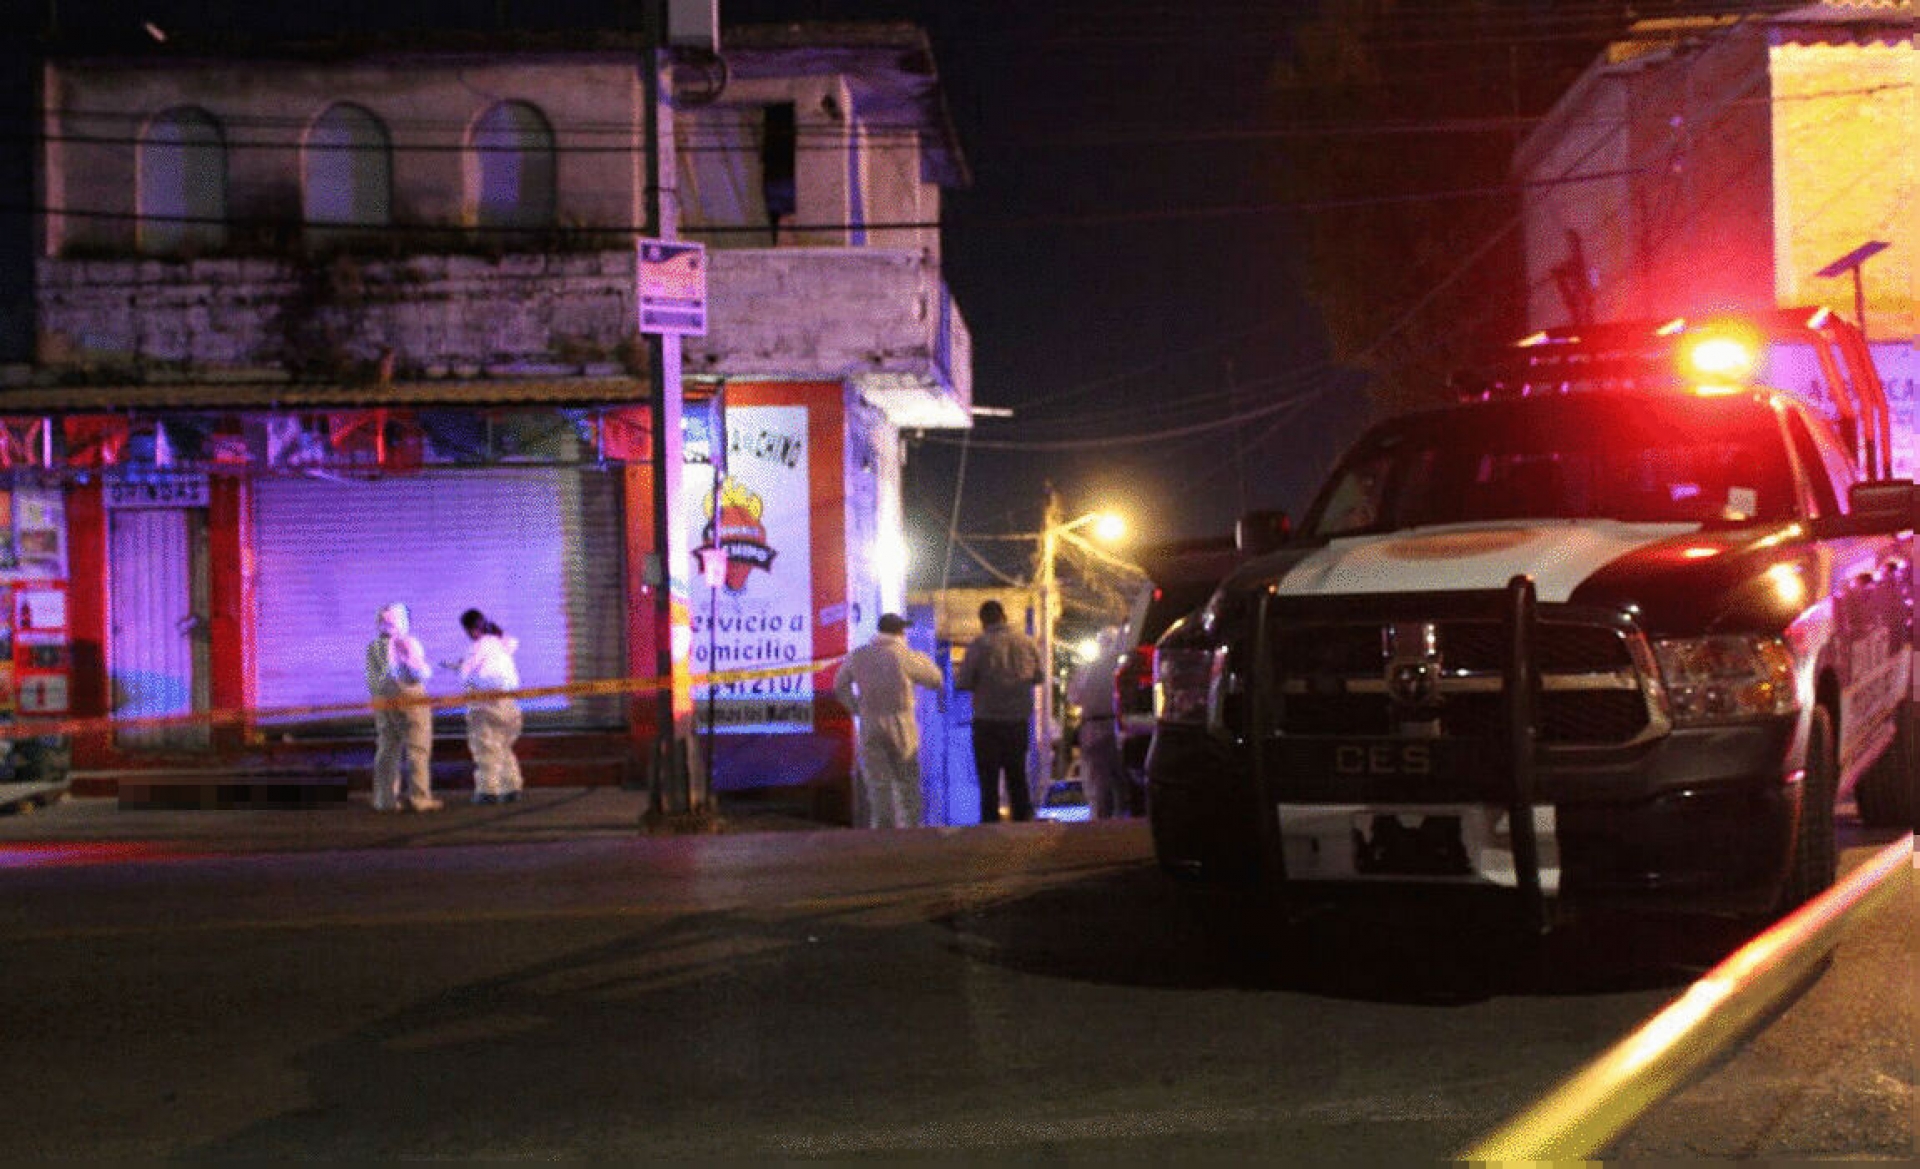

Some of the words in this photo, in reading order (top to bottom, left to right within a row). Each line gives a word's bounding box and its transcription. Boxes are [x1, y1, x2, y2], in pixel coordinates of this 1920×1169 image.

[690, 609, 782, 633] ervicio
[695, 638, 796, 662] omicilio
[1335, 745, 1430, 774] CES
